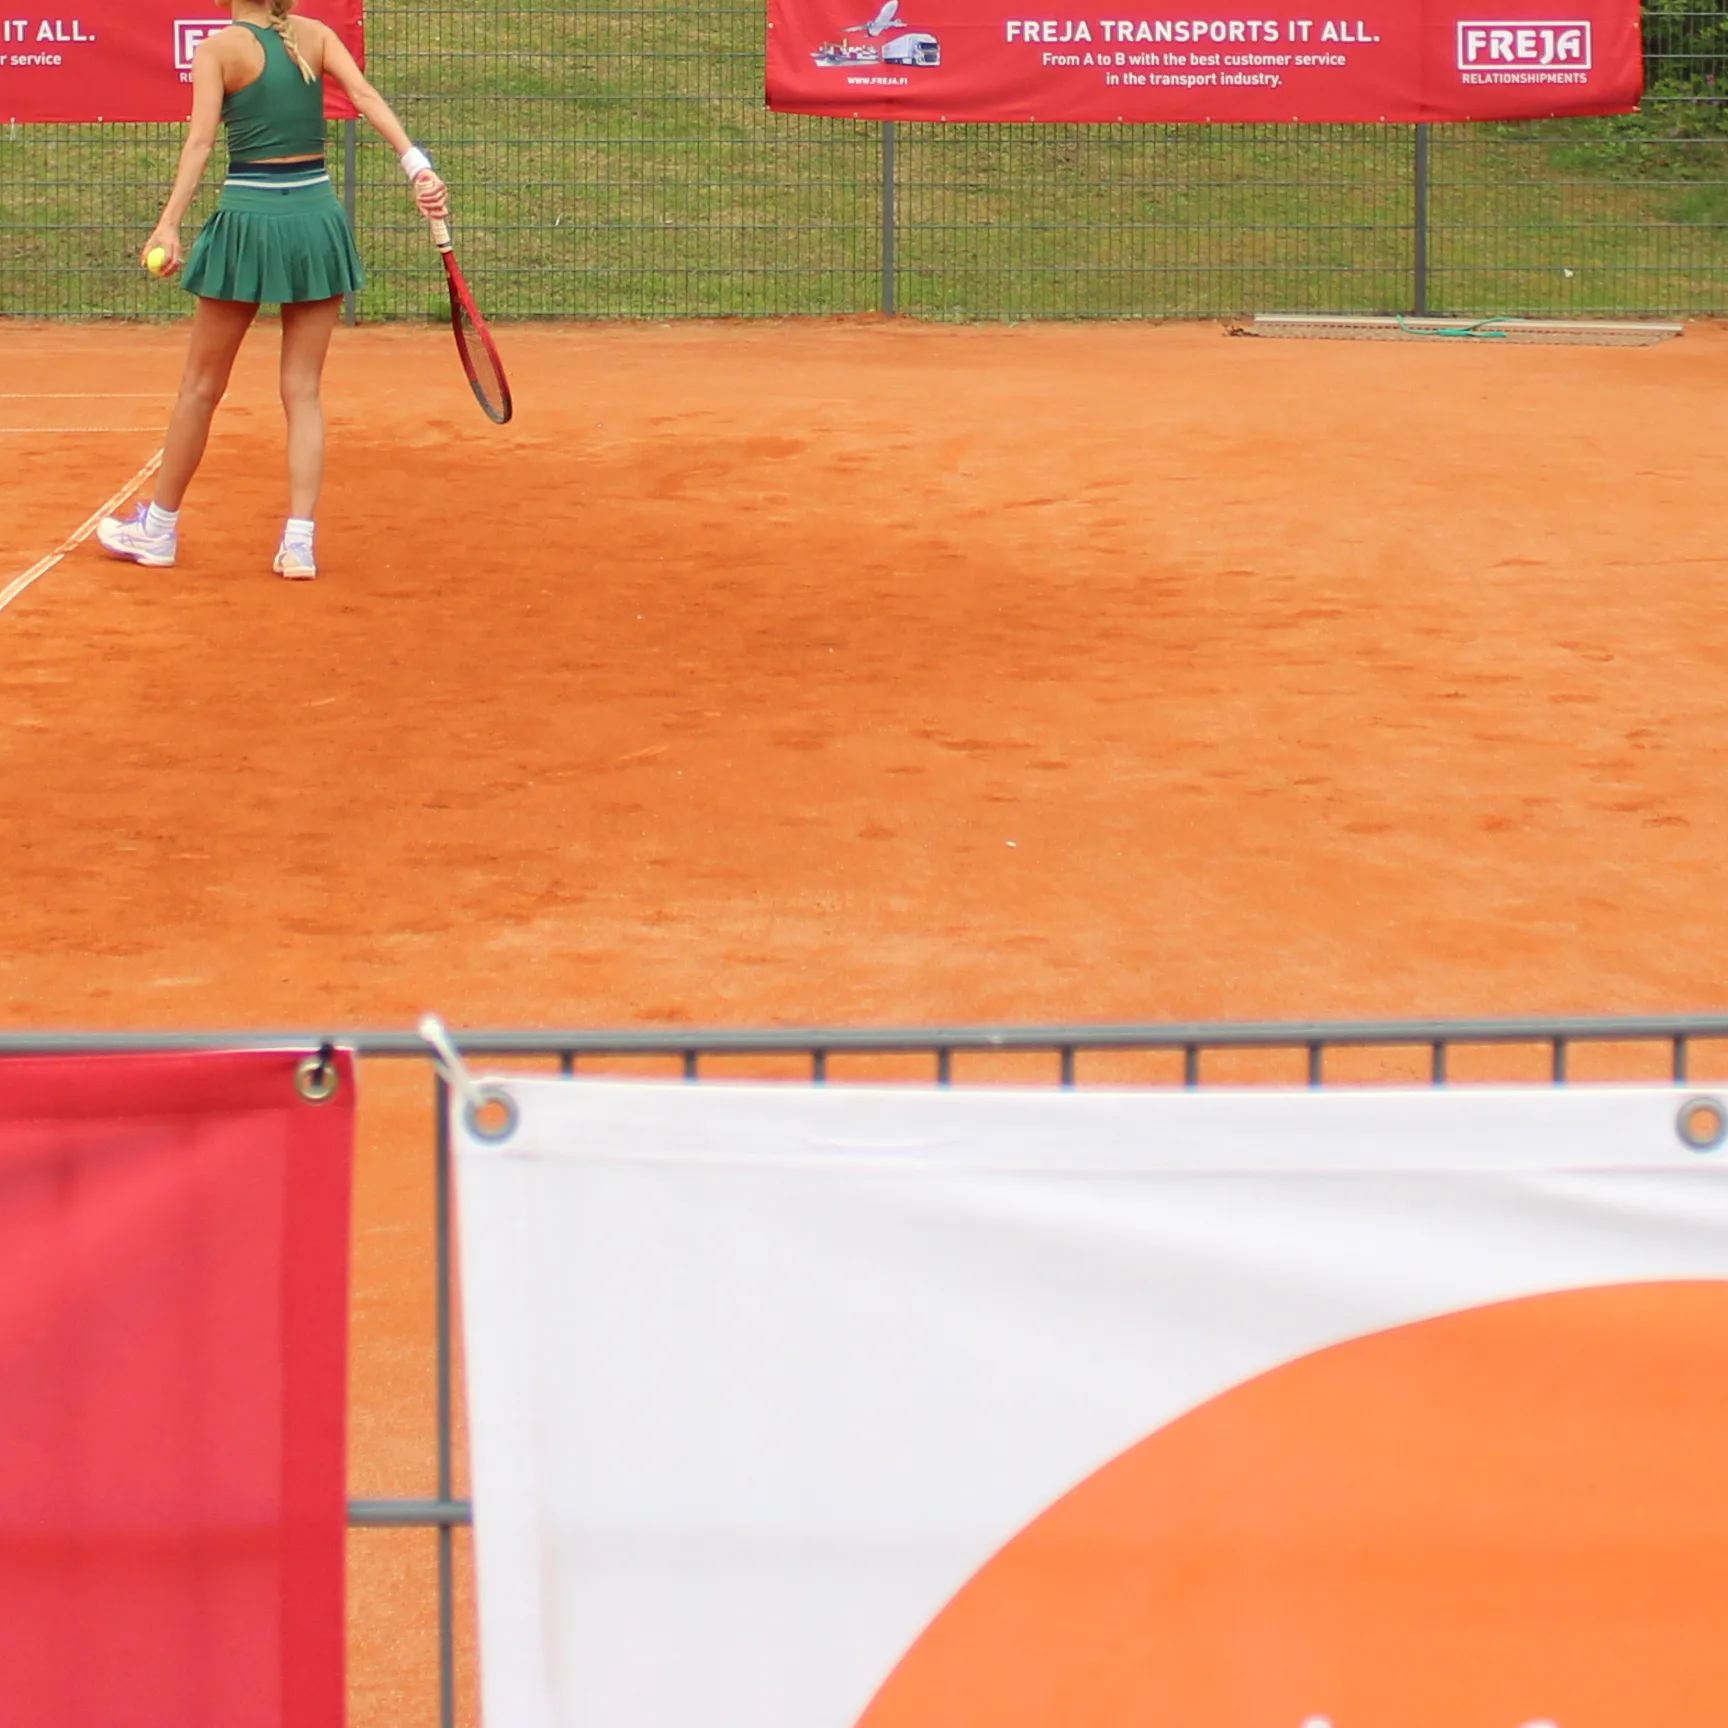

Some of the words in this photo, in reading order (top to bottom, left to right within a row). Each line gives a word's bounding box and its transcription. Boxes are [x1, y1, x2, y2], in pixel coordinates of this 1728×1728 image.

[4, 21, 27, 41] IT
[37, 20, 95, 41] ALL.
[1007, 21, 1091, 42] FREJA
[1100, 21, 1278, 41] TRANSPORTS
[1289, 21, 1312, 41] IT
[1321, 21, 1379, 41] ALL.
[1467, 30, 1581, 64] FREJA
[11, 52, 61, 65] service
[1043, 53, 1079, 65] From
[1084, 53, 1093, 65] A
[1097, 54, 1111, 65] to
[1116, 52, 1125, 65] B
[1129, 53, 1159, 65] with
[1164, 53, 1186, 65] the
[1190, 53, 1220, 65] best
[1224, 54, 1291, 65] customer
[1295, 53, 1345, 65] service
[1107, 72, 1119, 84] in
[1123, 72, 1146, 85] the
[1150, 73, 1216, 88] transport
[1221, 72, 1282, 87] industry.
[1462, 73, 1587, 83] RELATIONSHIPMENTS
